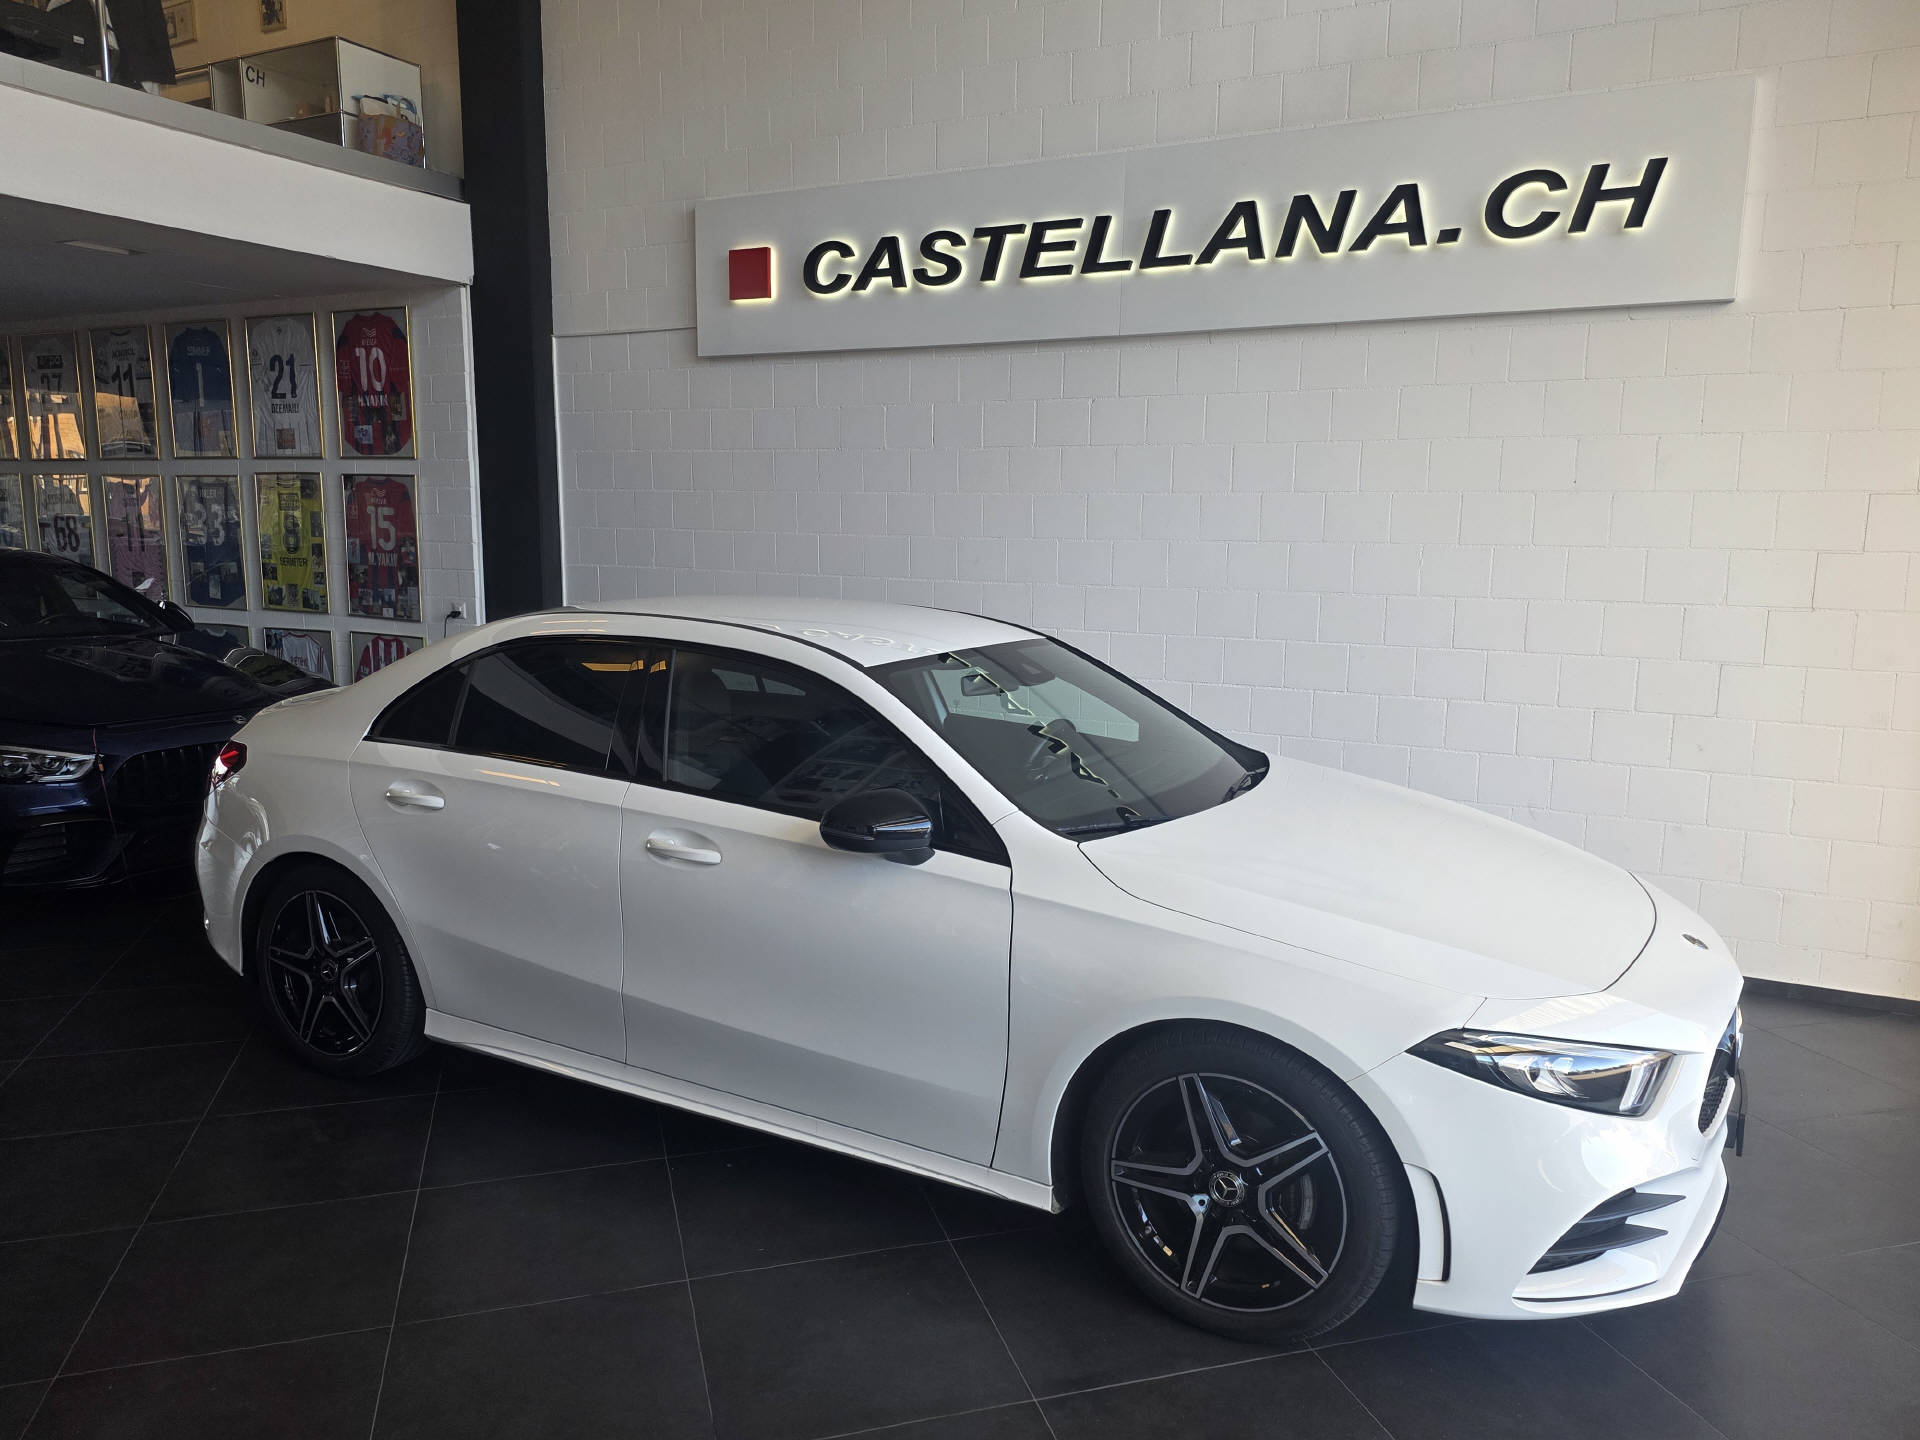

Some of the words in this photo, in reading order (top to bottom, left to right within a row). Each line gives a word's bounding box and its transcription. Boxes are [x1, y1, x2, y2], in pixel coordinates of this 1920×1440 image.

[246, 65, 265, 87] CH
[802, 157, 1668, 294] CASTELLANA.CH
[269, 353, 298, 400] 21
[355, 346, 387, 392] 10
[54, 513, 80, 552] 68
[366, 505, 396, 551] 15
